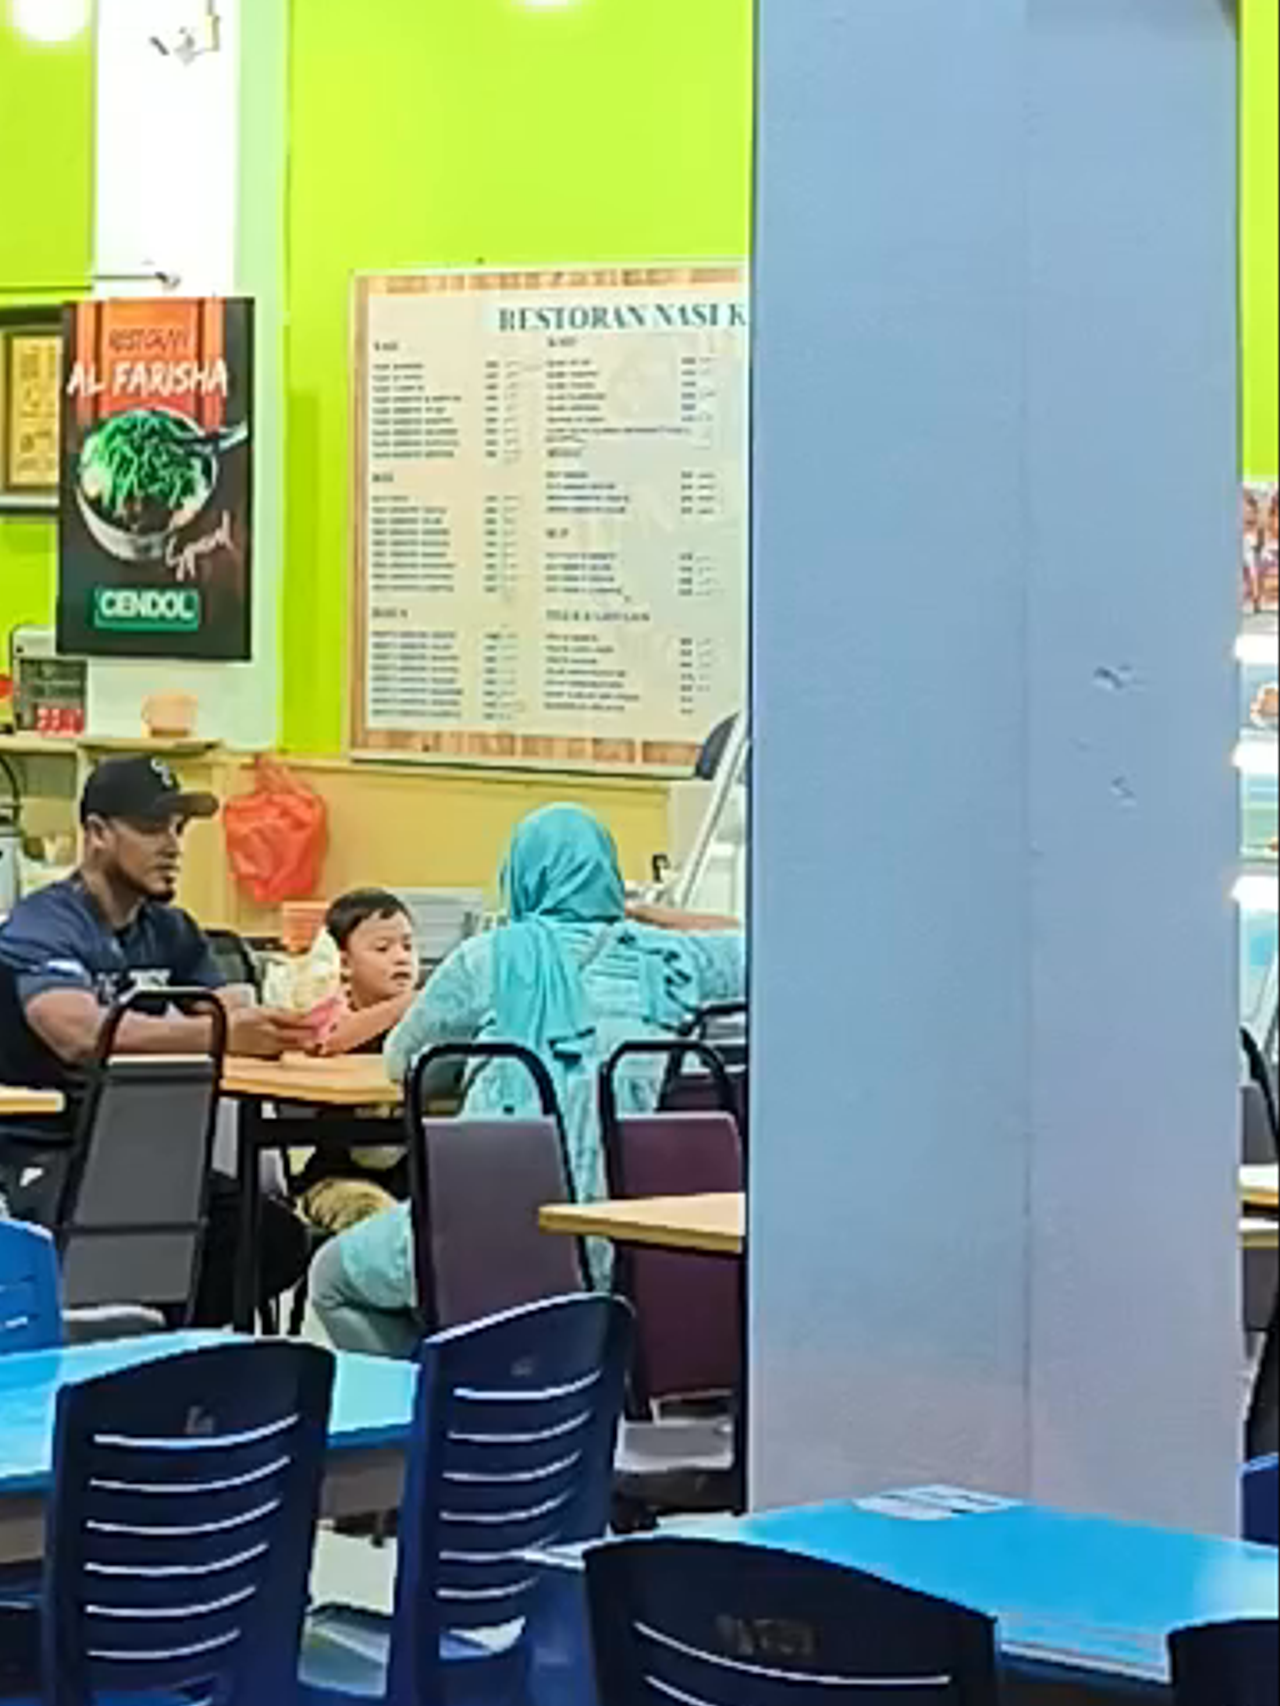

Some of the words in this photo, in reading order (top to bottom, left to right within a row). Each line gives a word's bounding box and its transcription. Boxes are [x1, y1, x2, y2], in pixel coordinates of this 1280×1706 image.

[498, 304, 646, 330] RESTORAN
[654, 303, 719, 328] NASI
[66, 360, 106, 397] AL
[111, 355, 229, 397] FARISHA
[98, 589, 195, 619] CENDOL
